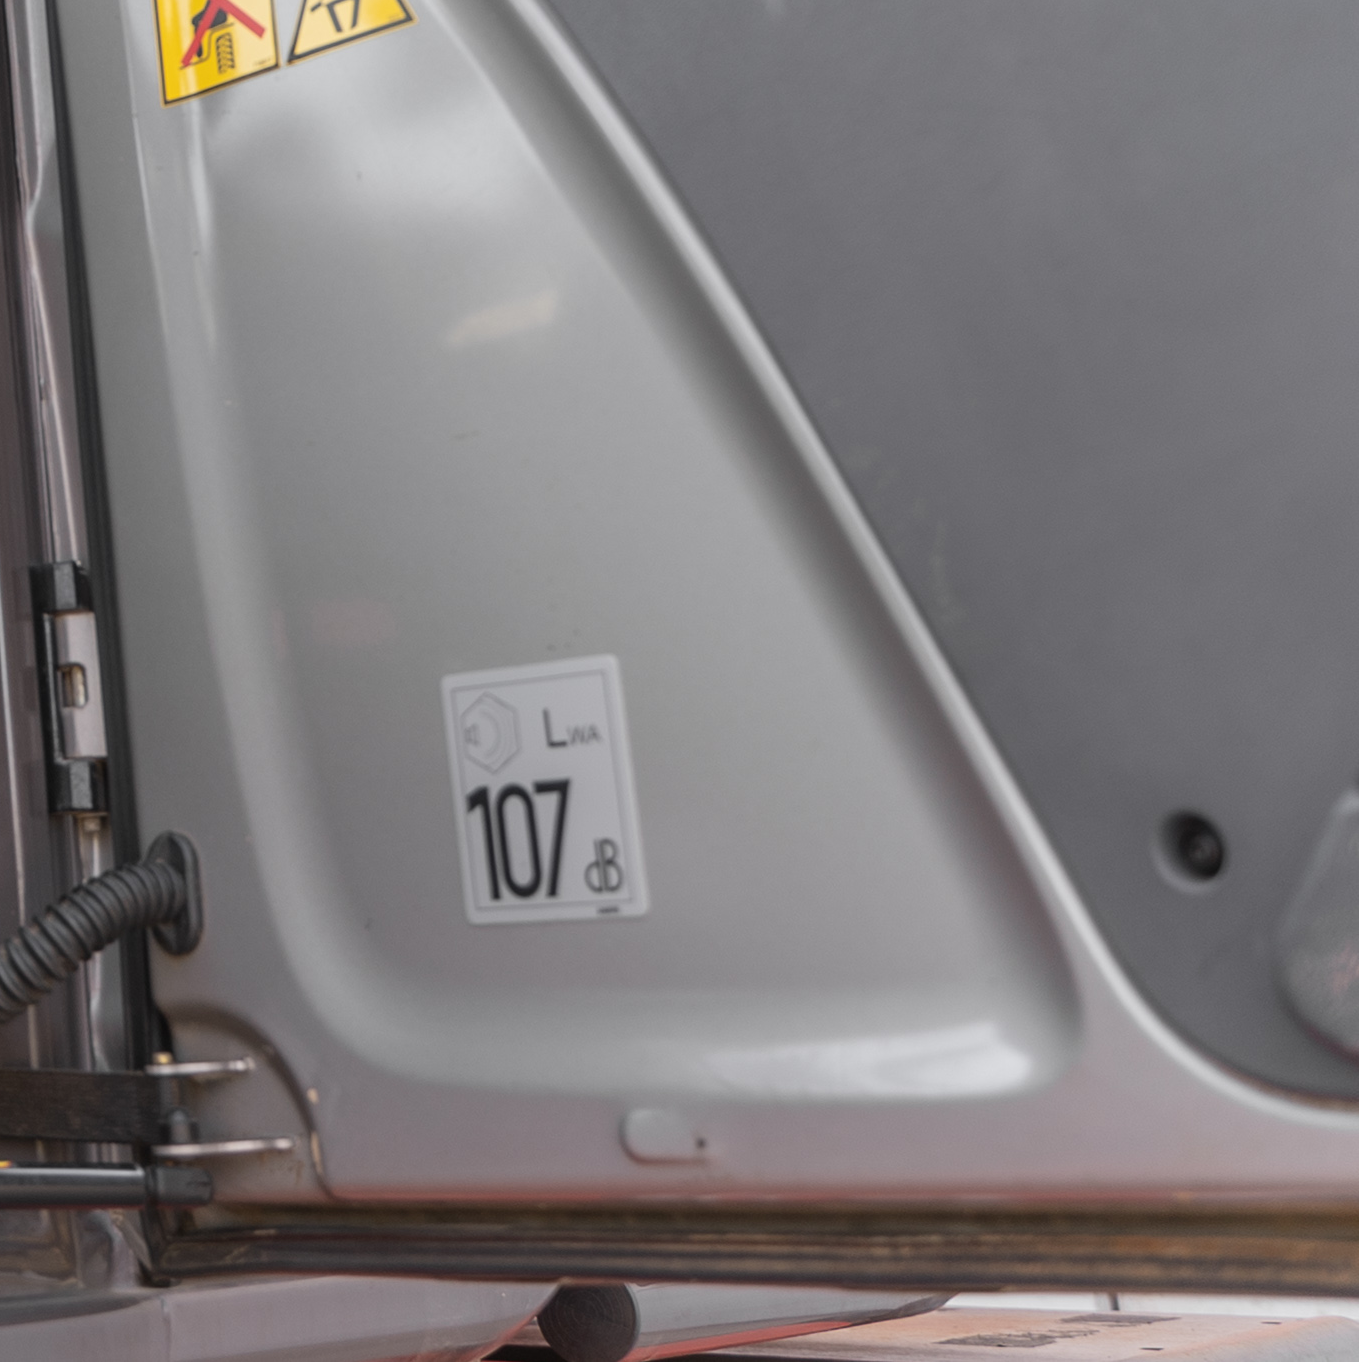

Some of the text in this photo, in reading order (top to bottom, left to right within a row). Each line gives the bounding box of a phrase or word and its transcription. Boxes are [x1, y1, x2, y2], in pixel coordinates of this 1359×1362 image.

[542, 707, 602, 748] LWA
[466, 777, 571, 900] 107
[583, 838, 624, 894] dB
